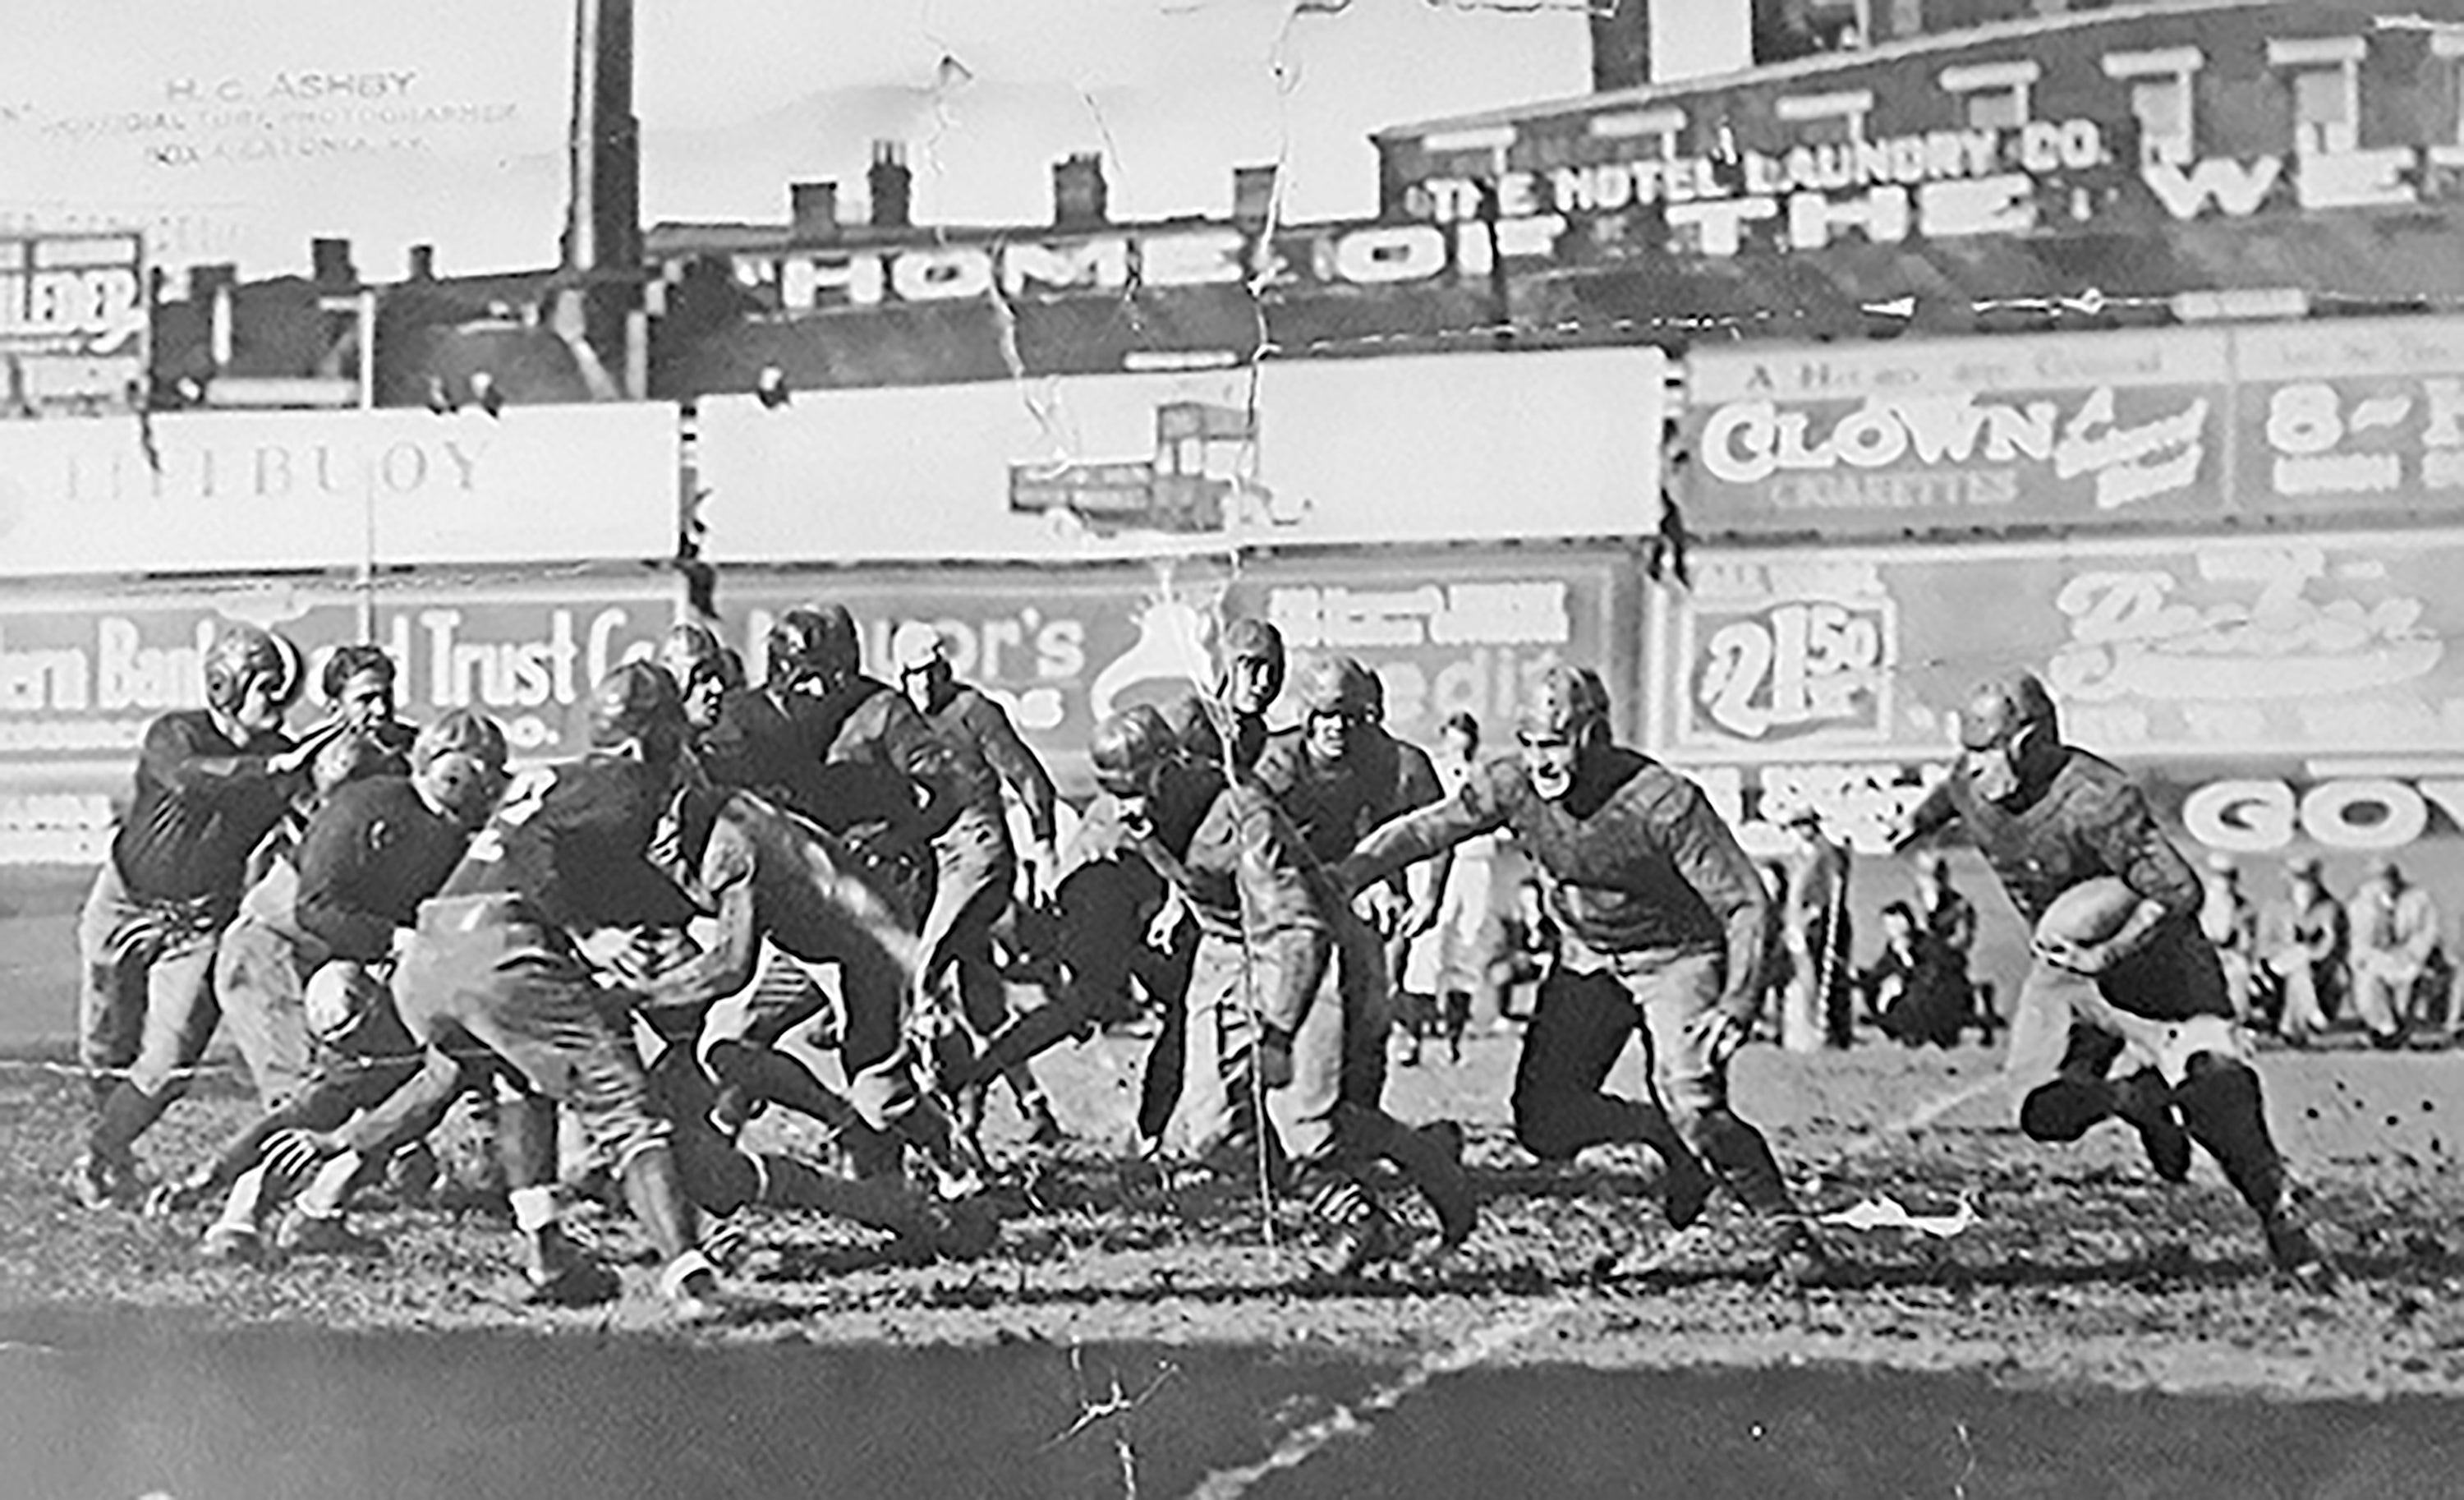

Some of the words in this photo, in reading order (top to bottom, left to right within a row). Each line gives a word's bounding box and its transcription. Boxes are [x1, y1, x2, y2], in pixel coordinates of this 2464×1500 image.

[2022, 119, 2113, 172] CO.
[1335, 212, 1567, 284] OF
[1664, 173, 2038, 253] THE
[1701, 398, 2057, 483] CLOWN
[421, 609, 578, 705] Trust
